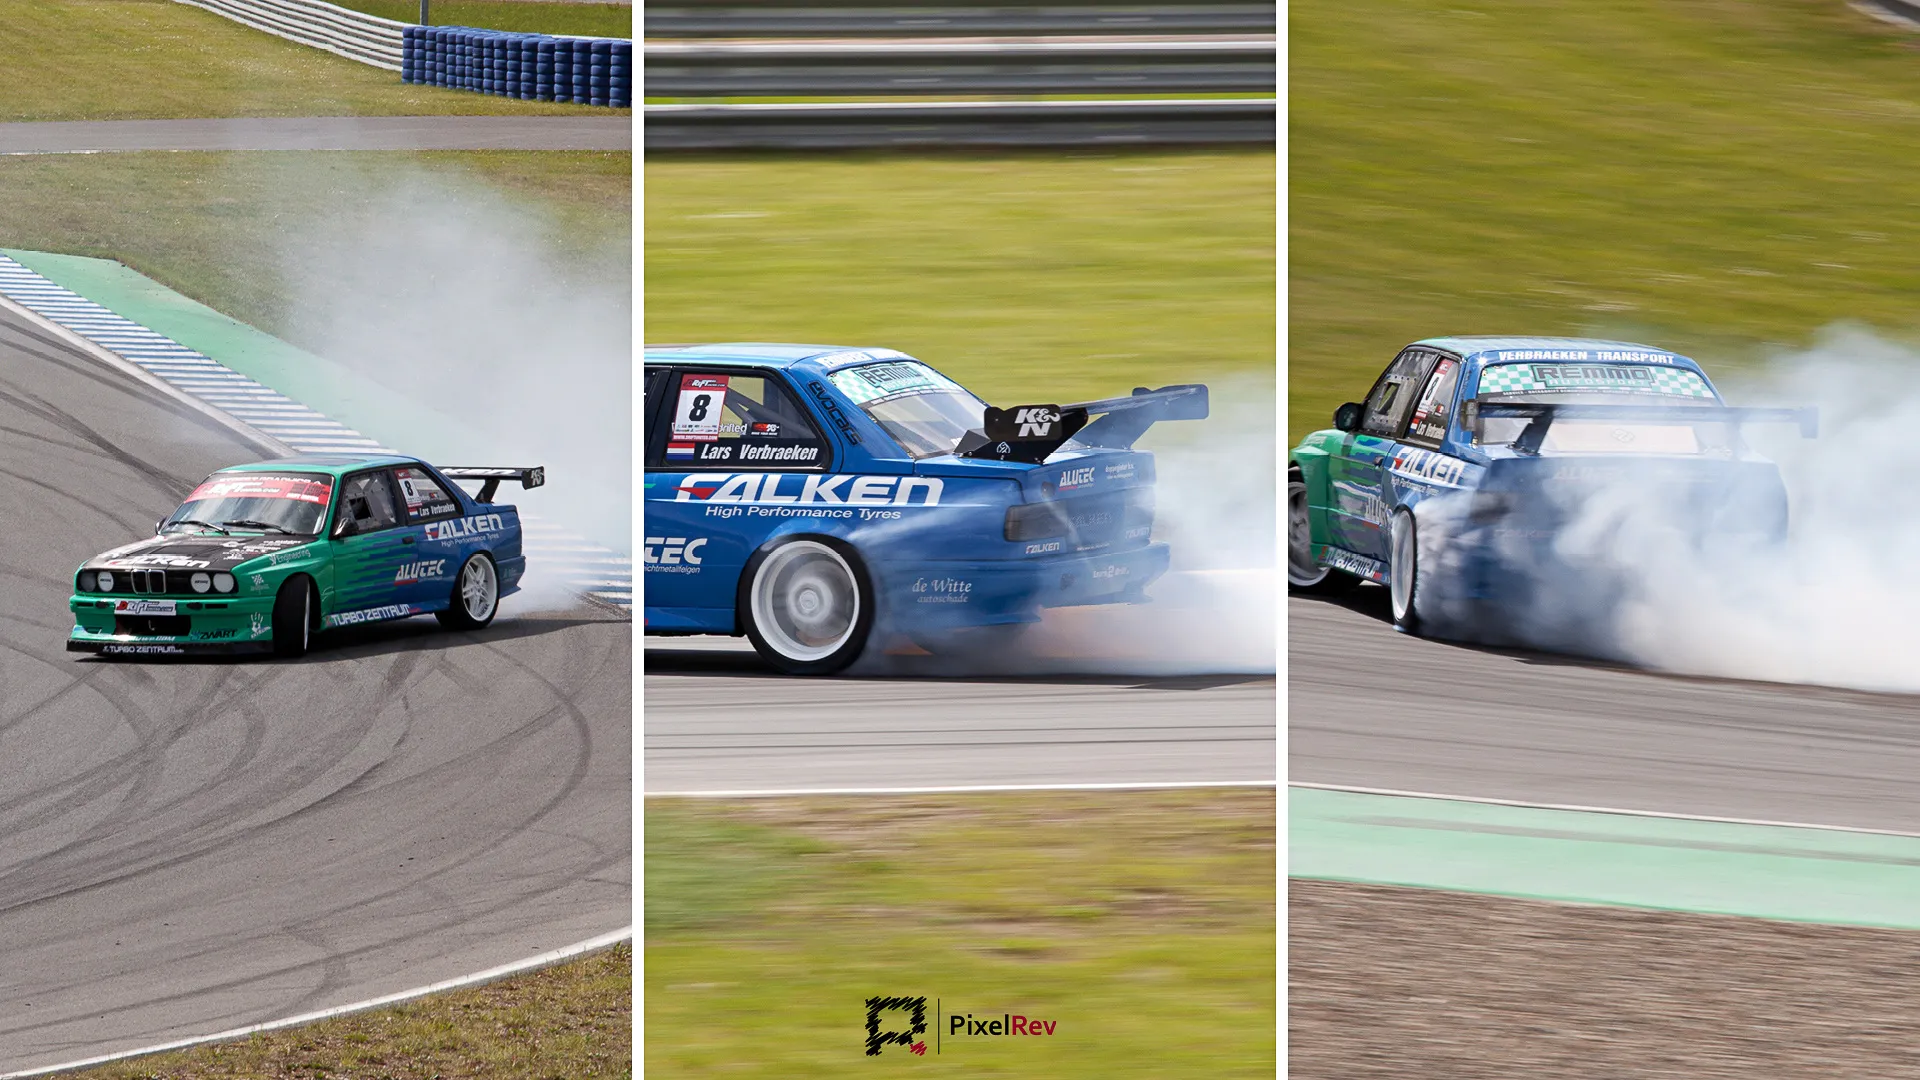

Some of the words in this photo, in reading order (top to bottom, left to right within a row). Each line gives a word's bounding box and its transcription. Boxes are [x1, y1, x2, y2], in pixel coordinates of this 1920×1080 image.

[1498, 350, 1587, 361] VERBRAEKEN
[1596, 350, 1675, 365] TRANSPORT
[1537, 366, 1650, 380] REMMO
[688, 394, 712, 422] 8
[807, 380, 864, 447] evocars
[700, 443, 732, 460] Lars
[739, 444, 818, 461] Verbraeken
[1391, 446, 1466, 485] FALKEN
[1059, 467, 1095, 487] ALUTEC
[404, 480, 414, 497] 8
[674, 473, 945, 507] FALKEN
[419, 507, 430, 517] Lars
[706, 505, 742, 519] High
[747, 506, 853, 518] Performance
[858, 508, 901, 520] Tyres
[425, 514, 504, 542] FALKEN
[440, 540, 455, 548] High
[455, 535, 487, 546] Performance
[487, 533, 500, 541] Tyres
[1025, 542, 1060, 554] FALKEN
[277, 549, 312, 563] Engineering
[394, 559, 446, 582] ALUTEC
[912, 577, 927, 593] de
[931, 578, 972, 593] Witte
[917, 593, 968, 604] autoschade
[331, 611, 365, 626] TURBO
[364, 603, 411, 621] ZENTRUM
[200, 629, 237, 640] ZWART
[136, 646, 176, 654] ZENTRUM
